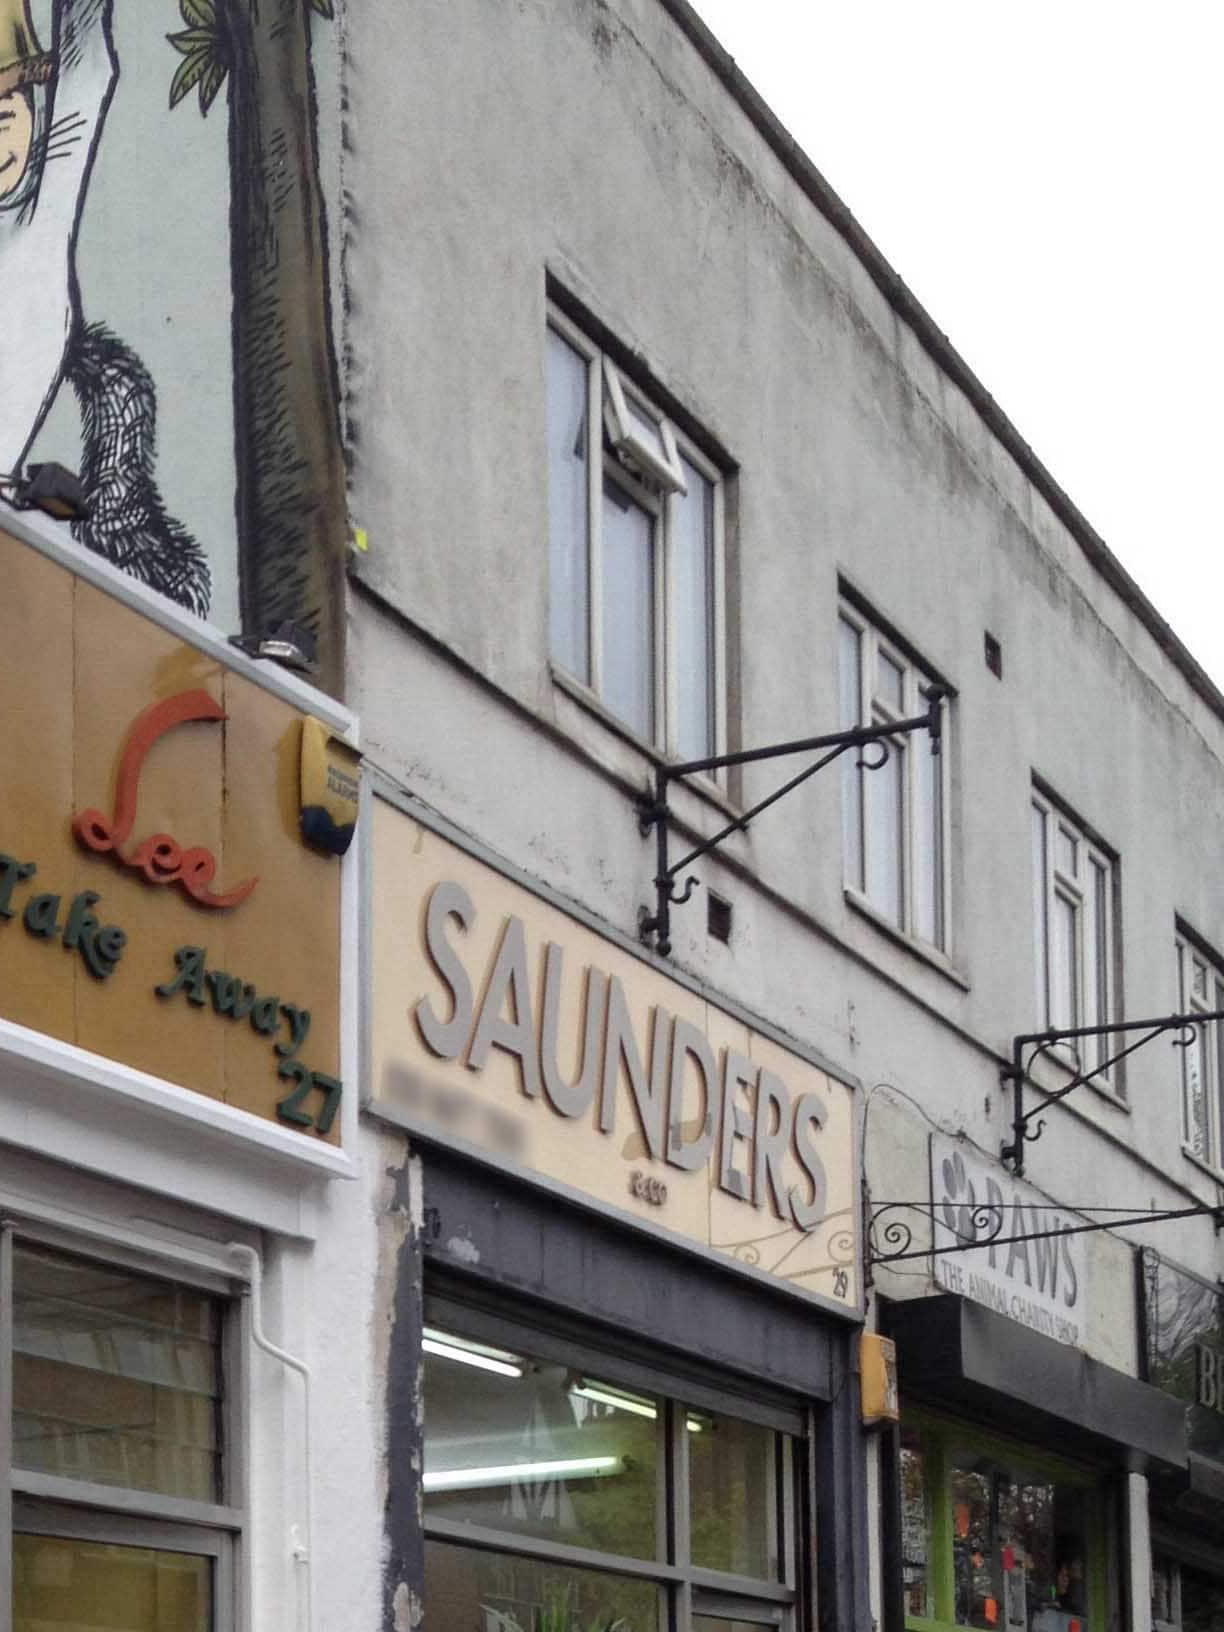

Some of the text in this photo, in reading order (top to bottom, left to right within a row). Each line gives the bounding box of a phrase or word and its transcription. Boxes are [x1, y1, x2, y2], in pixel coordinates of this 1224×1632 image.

[72, 688, 261, 909] Lee
[155, 946, 312, 1056] Away
[278, 1061, 344, 1133] 27
[413, 880, 829, 1233] SAUNDERS
[833, 1266, 849, 1299] 29
[985, 1176, 1077, 1308] PAWS
[941, 1259, 964, 1294] THE
[969, 1272, 1007, 1314] ANIMAL
[1009, 1295, 1055, 1339] CHARITY
